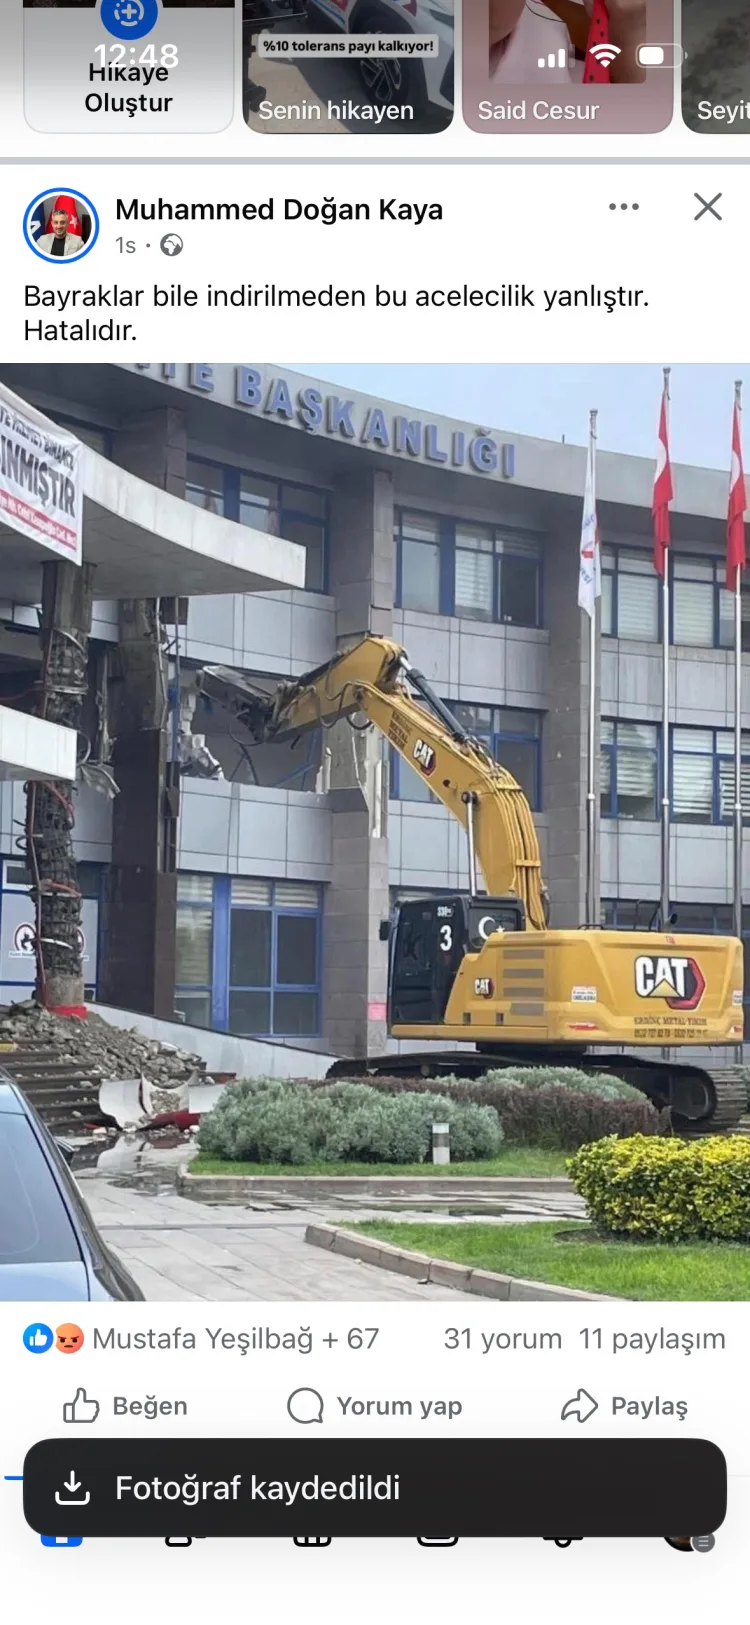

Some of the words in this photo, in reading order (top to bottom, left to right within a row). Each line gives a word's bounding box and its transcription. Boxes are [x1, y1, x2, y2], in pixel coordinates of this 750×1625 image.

[236, 365, 516, 477] BAŞKANLIĞI
[413, 739, 434, 768] CAT
[439, 924, 452, 951] 3
[474, 978, 490, 995] CAT
[635, 956, 688, 998] CAT
